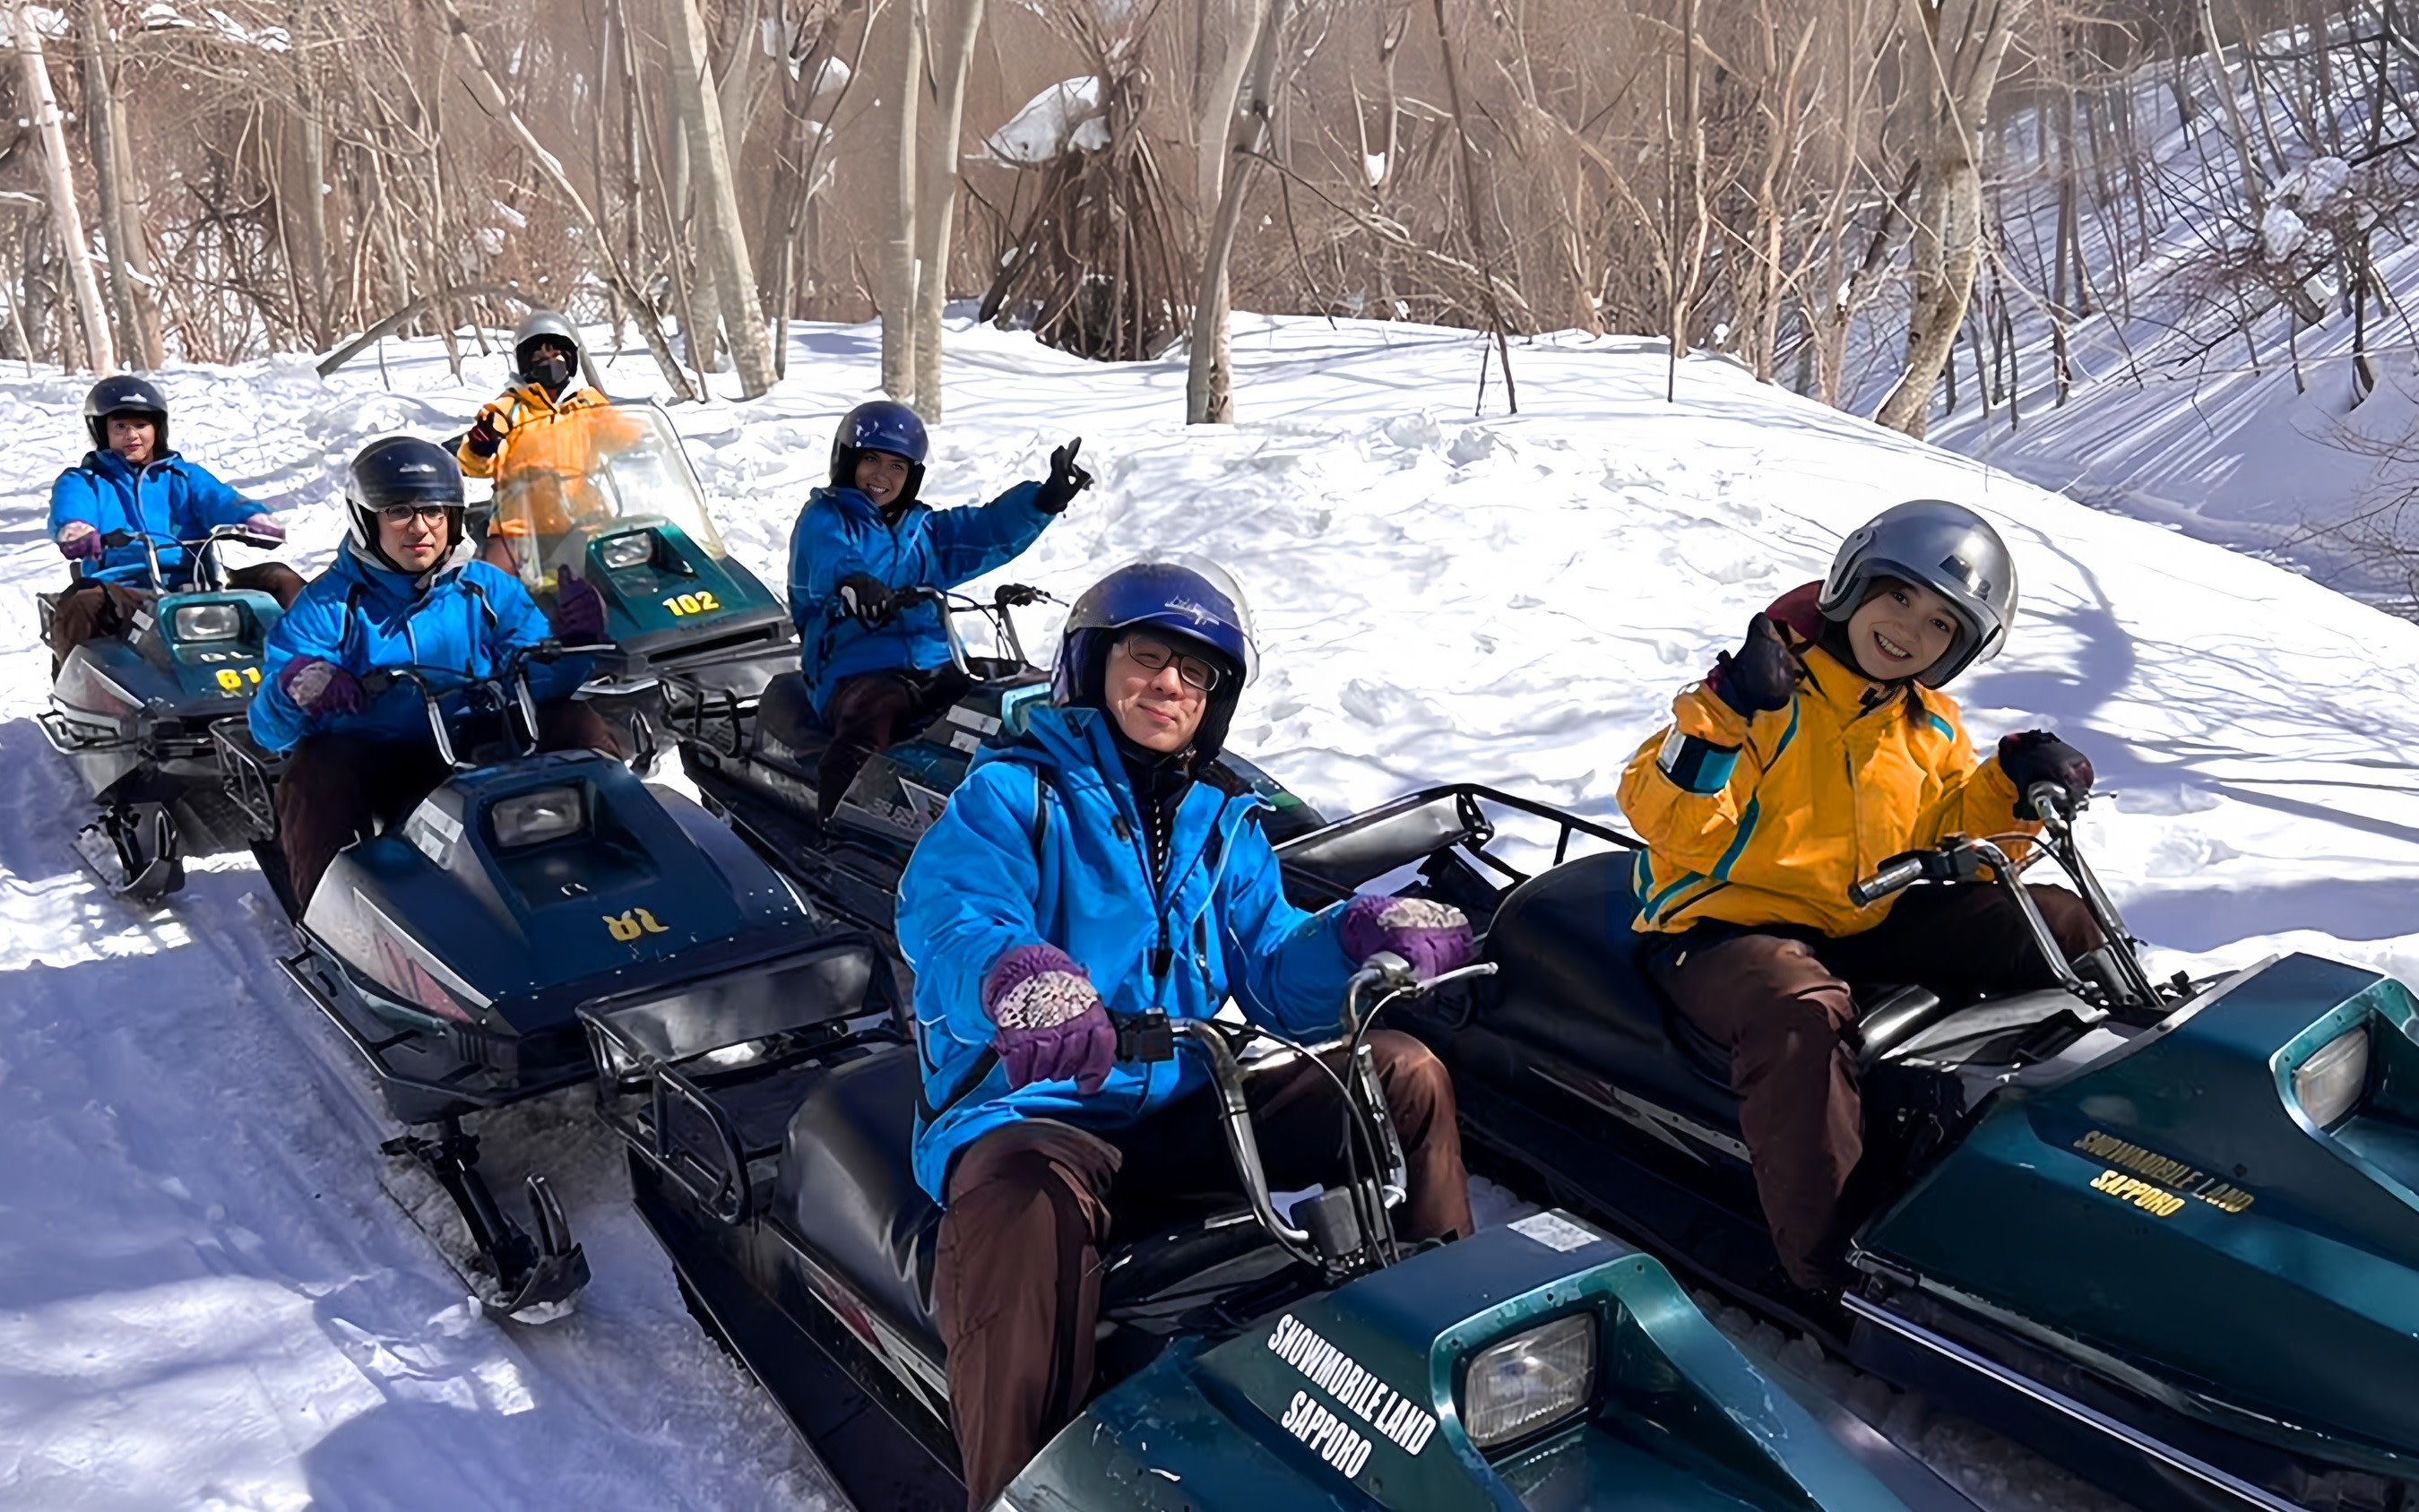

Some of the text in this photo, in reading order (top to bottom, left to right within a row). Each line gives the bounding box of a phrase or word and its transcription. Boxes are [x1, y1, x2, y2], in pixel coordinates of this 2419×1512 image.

[661, 591, 720, 617] 102
[2073, 1130, 2254, 1214] SNOWMOBILE LAND
[2090, 1170, 2186, 1217] SAPPORO
[1267, 1314, 1437, 1456] SNOWMOBILE LAND
[1281, 1390, 1372, 1479] SAPPORO
